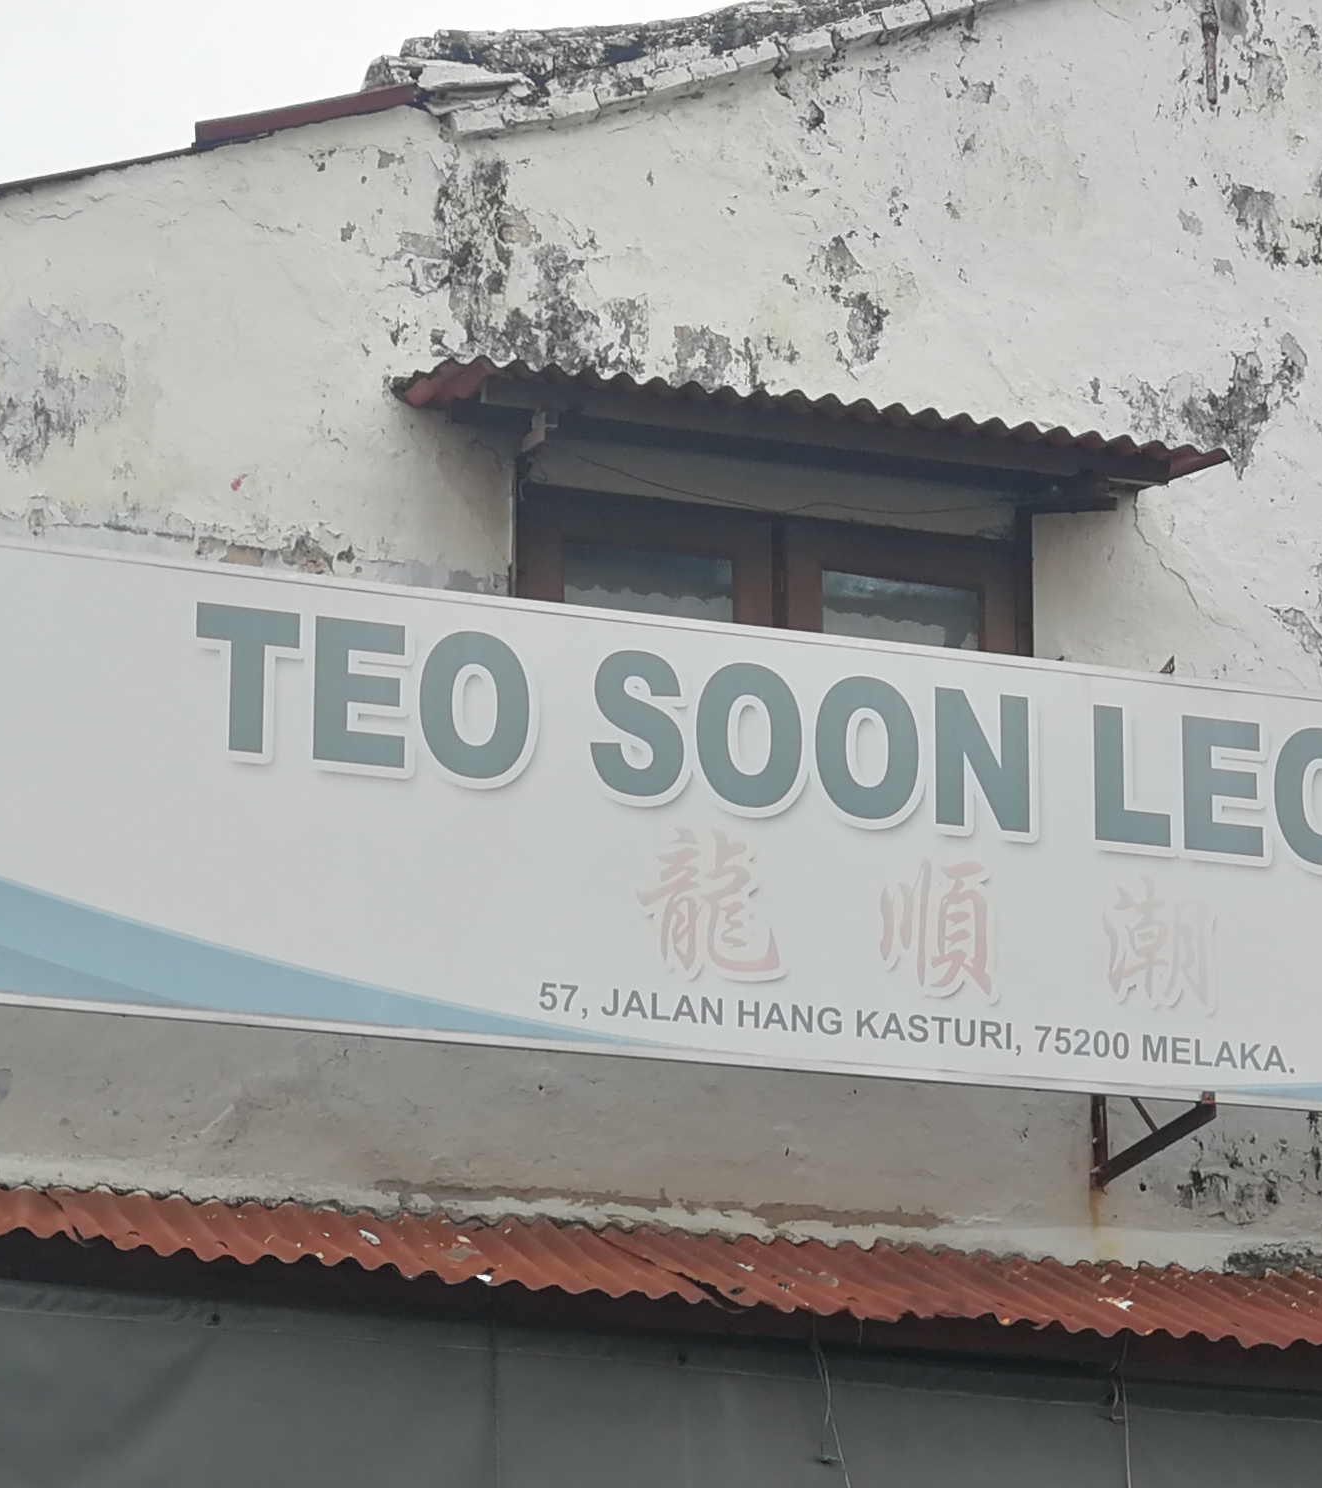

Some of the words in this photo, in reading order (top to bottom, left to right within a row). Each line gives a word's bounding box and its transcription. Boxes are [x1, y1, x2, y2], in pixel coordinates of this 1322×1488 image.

[196, 602, 530, 779] TEO
[590, 650, 1031, 833] SOON
[539, 982, 588, 1018] 57,
[601, 988, 723, 1026] JALAN
[737, 1000, 843, 1036] HANG
[856, 1011, 1022, 1056] KASTURI,
[1034, 1025, 1130, 1060] 75200
[1142, 1034, 1296, 1074] MELAKA.
